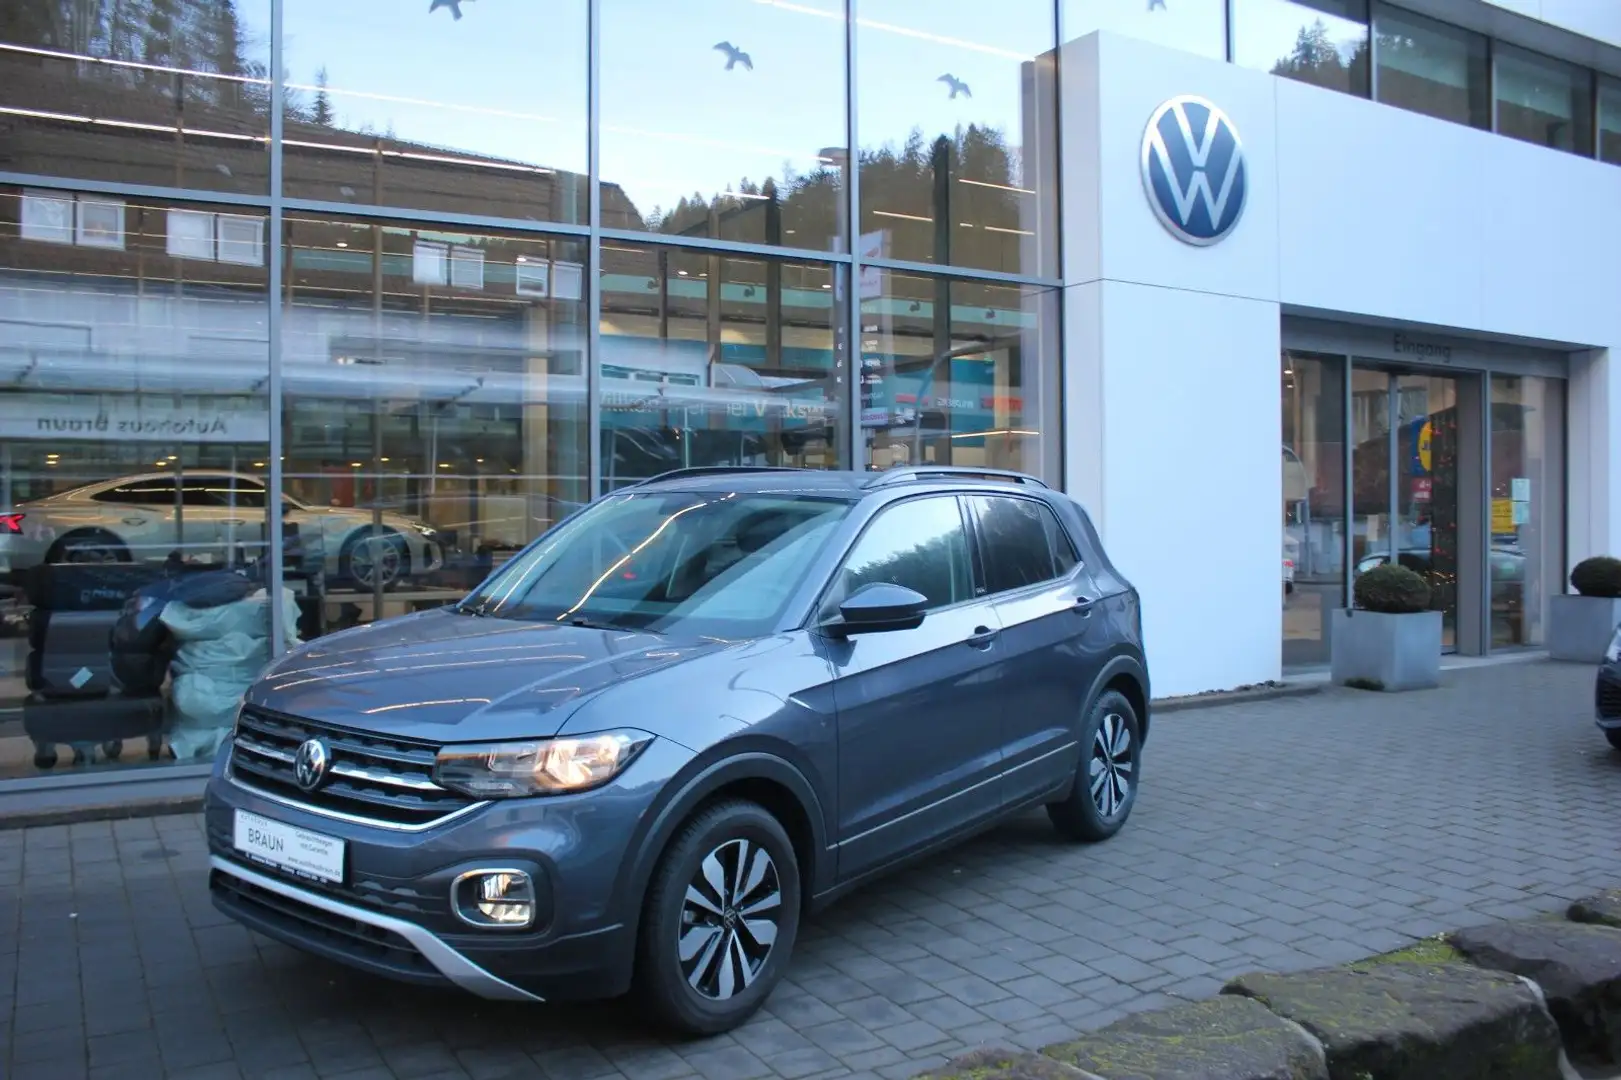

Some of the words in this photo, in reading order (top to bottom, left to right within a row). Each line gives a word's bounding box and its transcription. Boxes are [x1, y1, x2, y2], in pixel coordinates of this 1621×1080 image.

[1143, 98, 1246, 240] VW
[1394, 333, 1451, 363] Eingang
[248, 827, 284, 853] BRAUN
